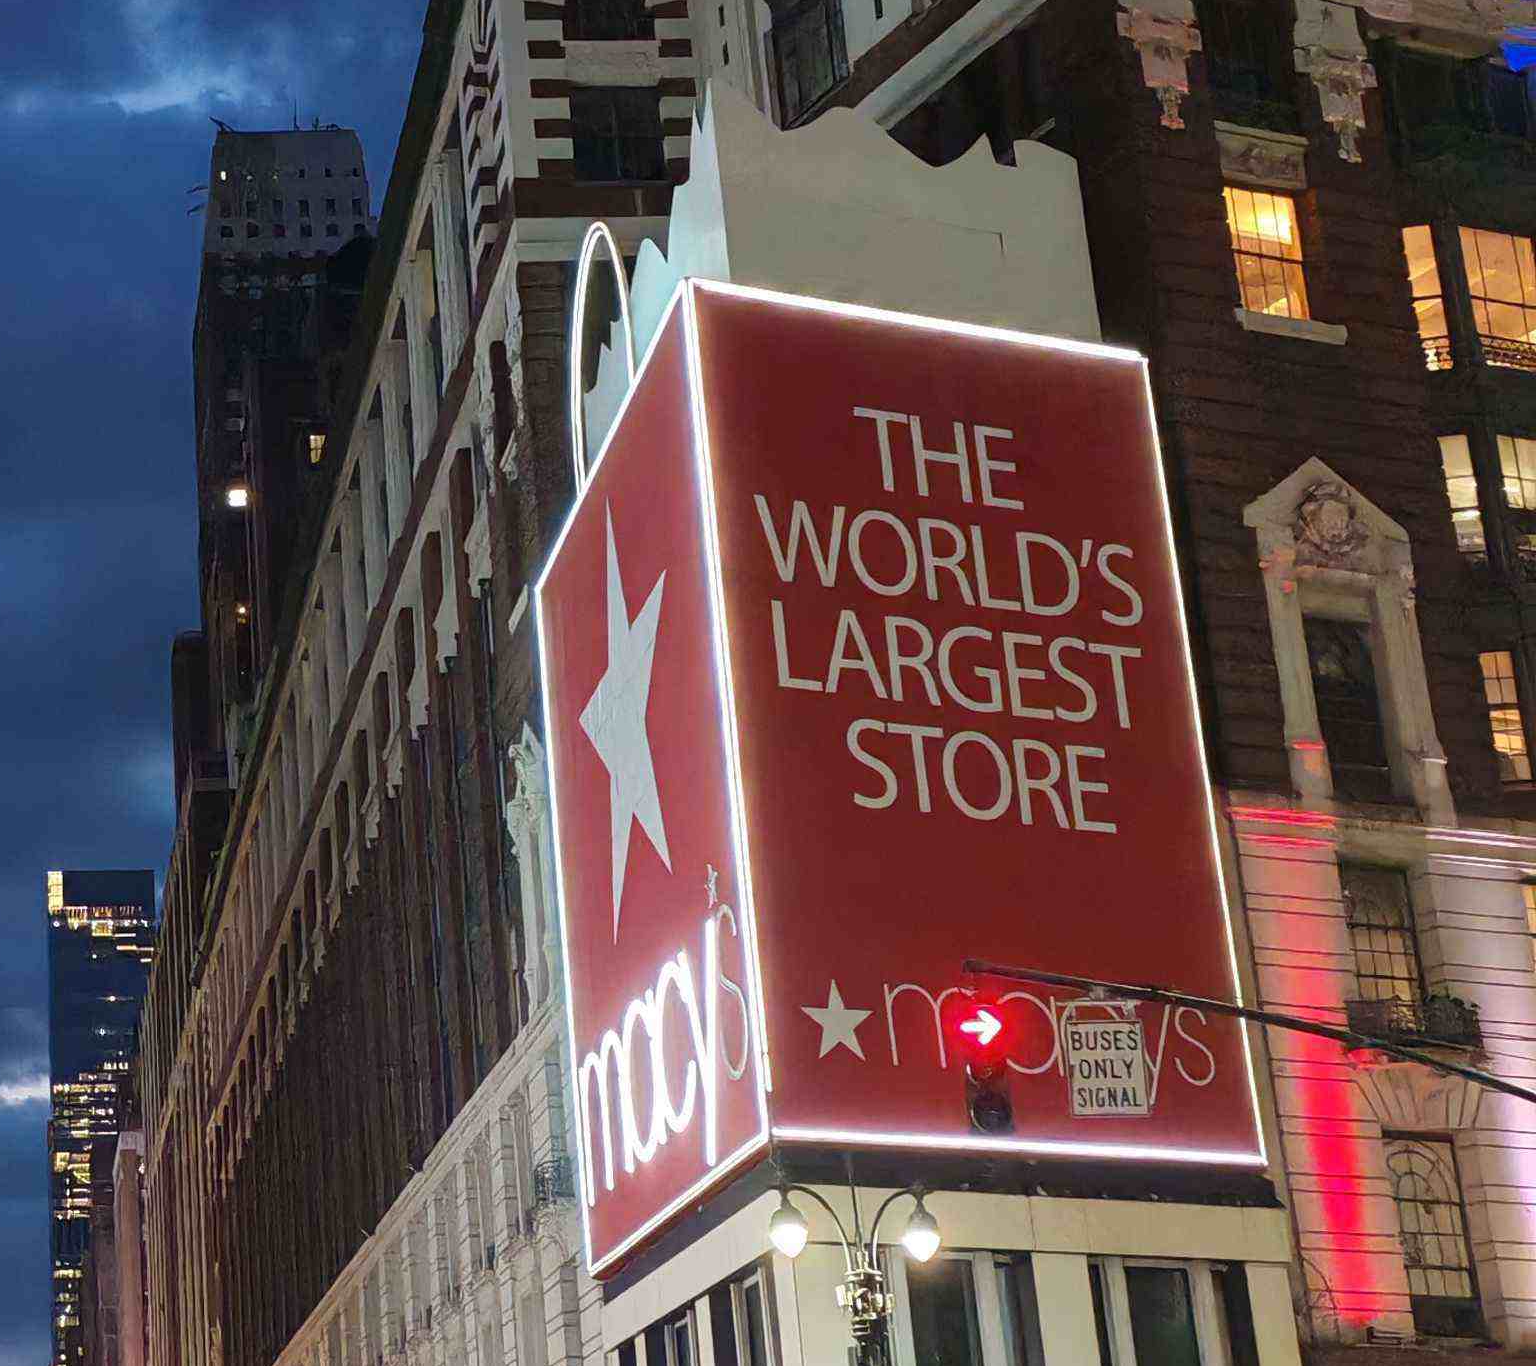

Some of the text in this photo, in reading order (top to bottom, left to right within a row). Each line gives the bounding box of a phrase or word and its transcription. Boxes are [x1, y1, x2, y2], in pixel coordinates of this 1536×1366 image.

[853, 406, 1024, 511] THE
[753, 493, 1143, 626] WORLD'S
[771, 599, 1142, 730] LARGEST
[846, 718, 1117, 834] STORE
[1071, 1029, 1139, 1051] BUSES
[1079, 1058, 1134, 1079] ONLY
[1077, 1087, 1143, 1108] SIGNAL
